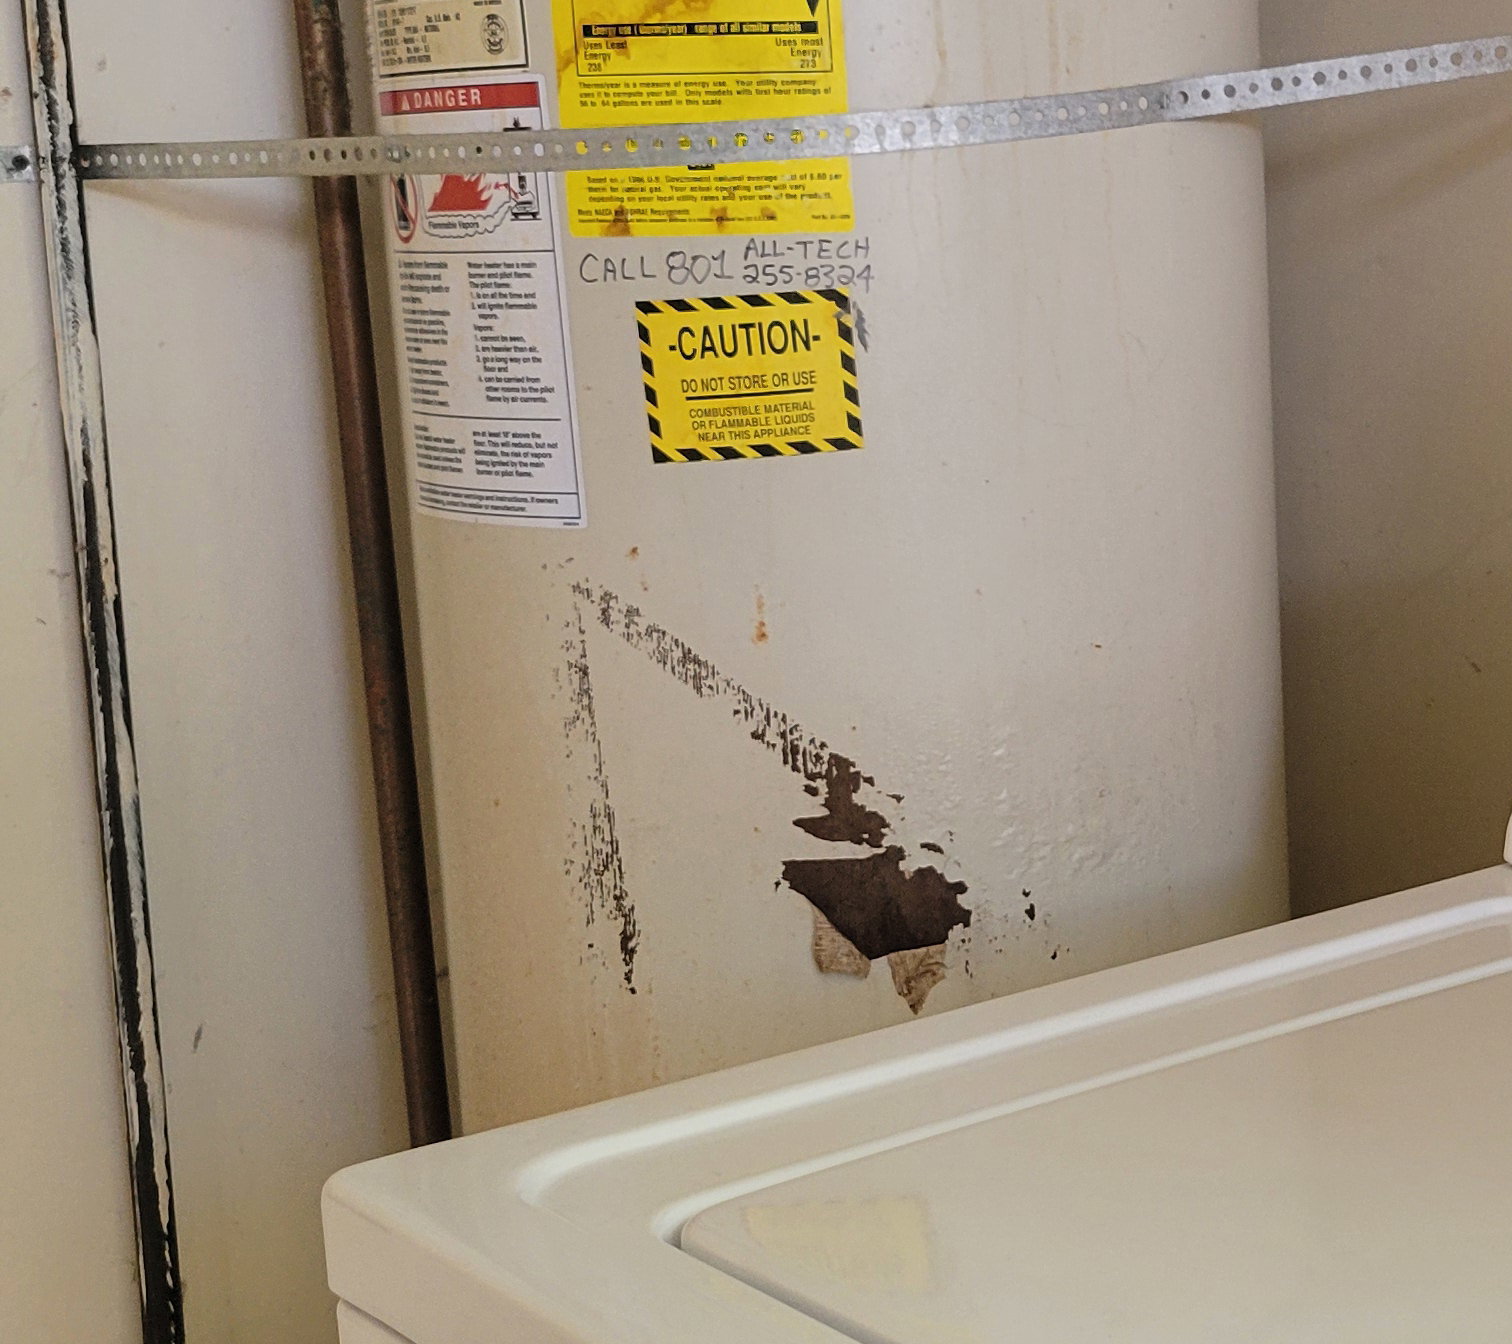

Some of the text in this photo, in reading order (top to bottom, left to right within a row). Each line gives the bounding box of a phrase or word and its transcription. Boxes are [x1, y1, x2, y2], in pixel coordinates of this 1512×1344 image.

[413, 88, 482, 110] DANGER
[743, 236, 870, 261] ALL-TECH
[579, 250, 734, 285] CALL 801
[743, 263, 875, 294] 255-8324
[681, 370, 817, 394] DO NOT STORE OR USE
[689, 400, 815, 419] COMBUSTIBLE MATERIAL
[691, 412, 815, 431] OR FLAMMABLE LIQUIDS
[698, 425, 811, 443] NEAR THIS APPLIANCE
